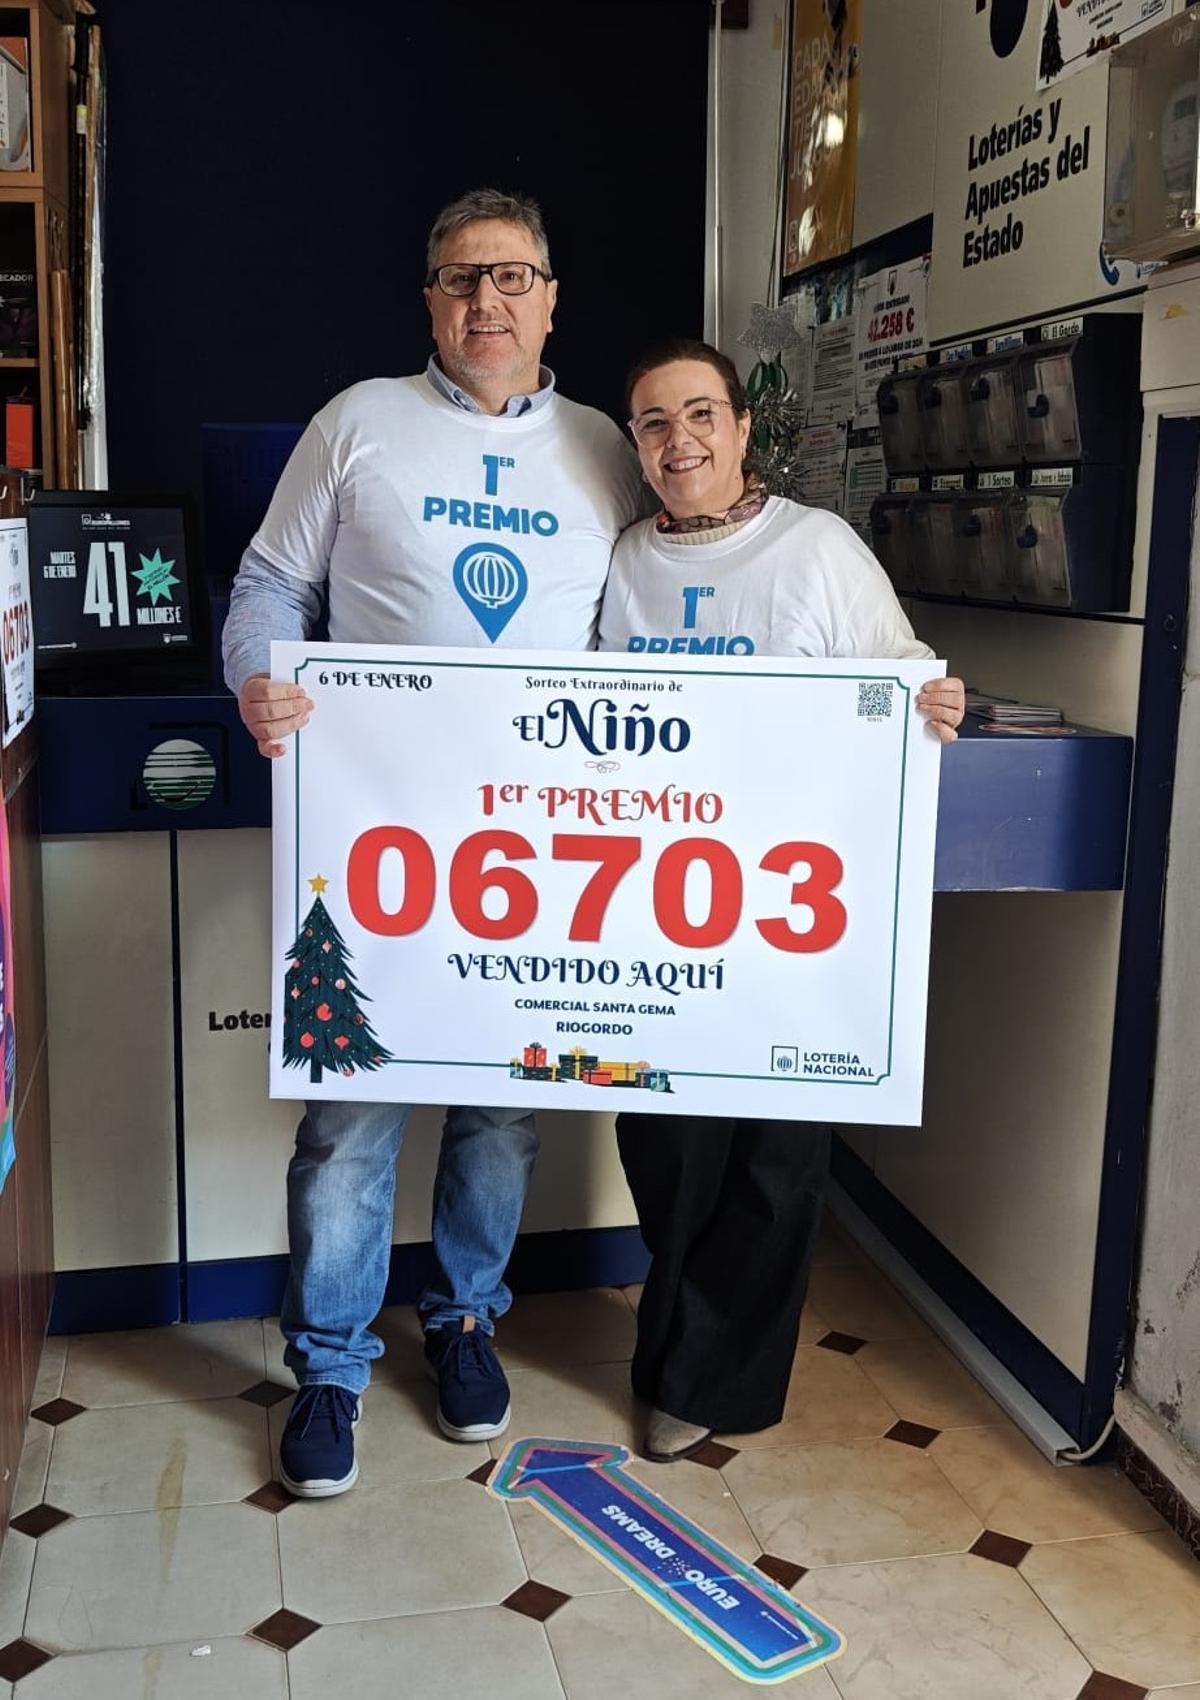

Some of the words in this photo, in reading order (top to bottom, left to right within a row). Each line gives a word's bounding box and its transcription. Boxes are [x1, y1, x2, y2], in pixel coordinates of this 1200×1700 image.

[967, 106, 1042, 172] Loterías
[1048, 98, 1062, 142] y
[965, 156, 1050, 221] Apuestas
[1056, 126, 1091, 178] del
[962, 213, 1024, 269] Estado
[423, 496, 559, 537] PREMIO
[83, 542, 131, 627] 41
[627, 636, 755, 656] PREMIO
[319, 671, 329, 686] 6
[333, 671, 361, 687] DE
[364, 672, 433, 691] ENERO
[525, 676, 567, 690] Sorteo
[570, 677, 664, 693] Extraordinario
[668, 680, 683, 692] de
[512, 713, 544, 742] El
[544, 698, 691, 757] Niño
[478, 782, 529, 816] 1er
[537, 785, 724, 826] PREMIO
[346, 825, 848, 955] 06703
[447, 953, 621, 986] VENDIDO
[624, 957, 724, 996] AQUÍ
[514, 998, 591, 1013] COMERCIAL
[593, 1001, 636, 1015] SANTA
[638, 1003, 676, 1017] GEMA
[556, 1021, 633, 1036] RIOGORDO
[803, 1050, 861, 1065] LOTERÍA
[803, 1063, 875, 1079] NACIONAL
[600, 1503, 677, 1560] DREAMS
[684, 1568, 740, 1610] EURO
